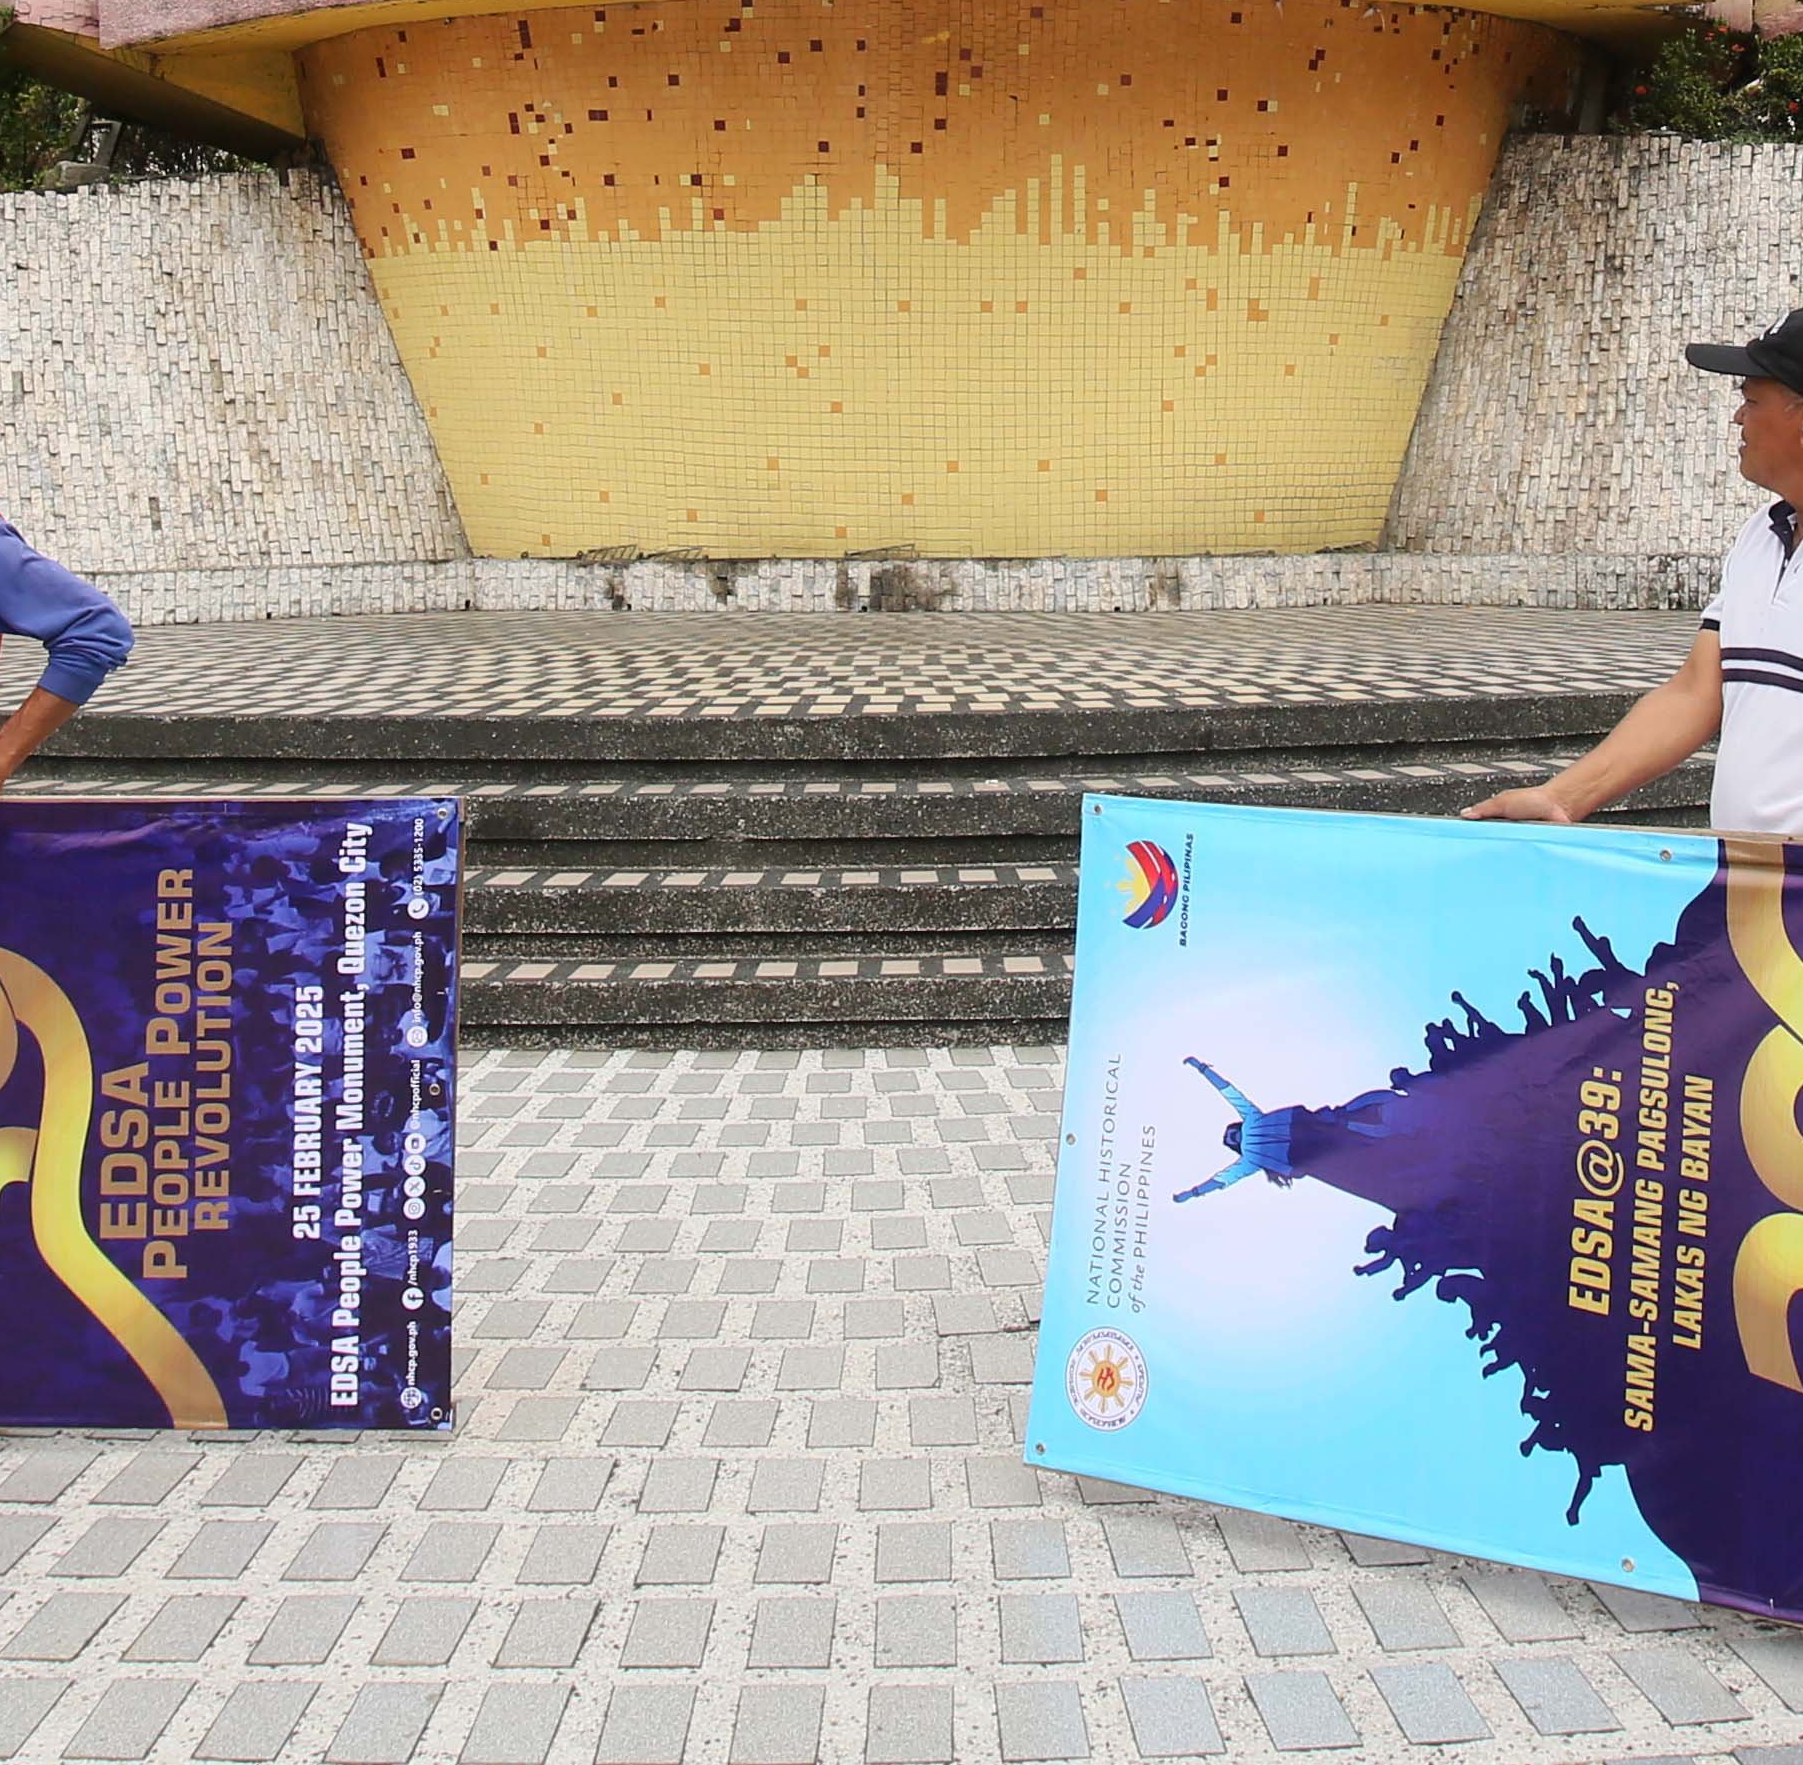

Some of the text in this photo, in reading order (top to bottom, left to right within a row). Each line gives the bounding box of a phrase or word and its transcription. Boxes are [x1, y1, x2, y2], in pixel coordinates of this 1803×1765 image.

[410, 931, 425, 1023] info@nhcp.gov.ph
[413, 818, 425, 896] (02) 5335-1200
[1182, 833, 1193, 892] PILIPINAS
[100, 1061, 149, 1240] EDSA
[143, 868, 193, 1279] PEOPLE POWER
[194, 921, 232, 1230] REVOLUTION
[293, 985, 323, 1239] 25 FEBRUARY 2025
[331, 822, 372, 1406] EDSA People Power Monument, Quezon City
[1086, 1053, 1121, 1305] NATIONAL HISTORICAL
[1568, 1066, 1624, 1316] EDSA@39:
[1106, 1163, 1132, 1309] COMMISSION
[1128, 1125, 1155, 1314] of the PHILIPPINES
[1624, 980, 1679, 1432] SAMA-SAMANG PAGSULONG,
[1672, 1075, 1713, 1349] LAKAS NG BAYAN
[405, 1321, 419, 1386] nhcp.gov.ph
